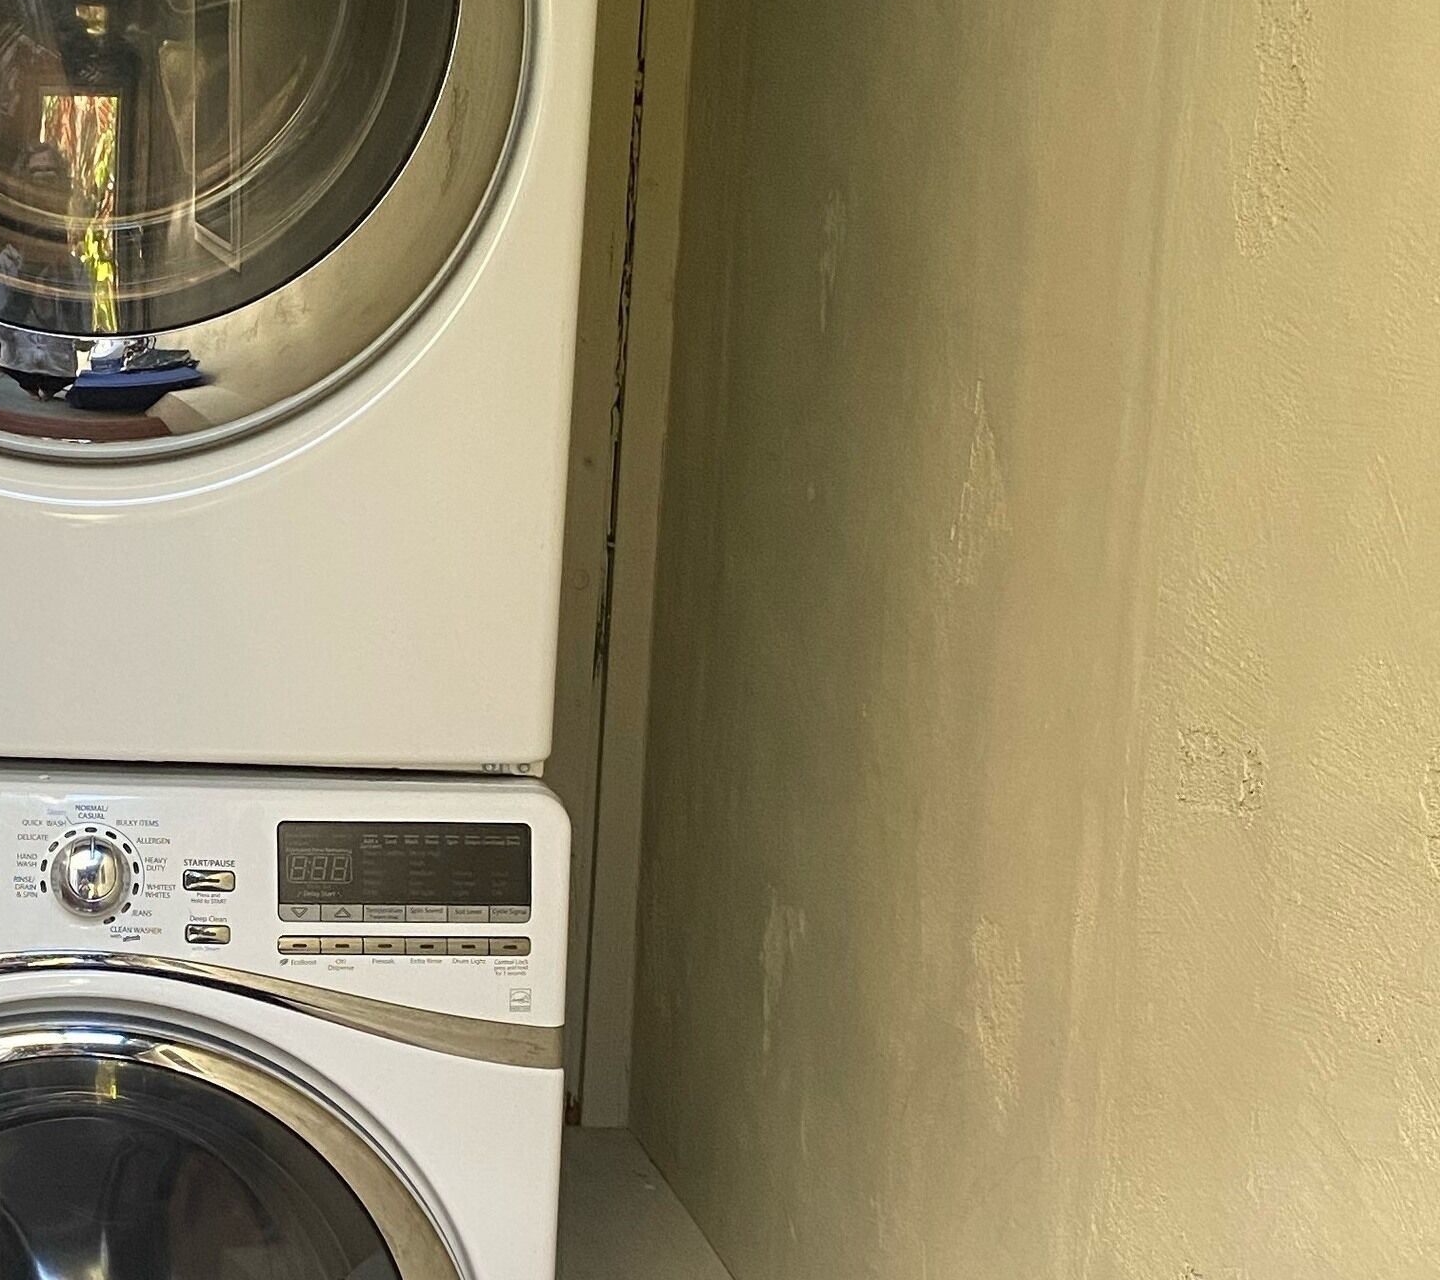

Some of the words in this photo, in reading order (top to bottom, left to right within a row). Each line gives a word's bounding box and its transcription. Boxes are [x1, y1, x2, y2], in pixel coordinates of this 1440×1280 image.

[75, 804, 109, 813] NORMAL/
[77, 812, 105, 820] CASUAL
[46, 820, 67, 828] WASH
[115, 819, 138, 827] BULKY
[17, 833, 49, 841] DELICATE
[136, 837, 171, 845] ALLERGEN
[144, 857, 168, 865] HEAVY
[183, 858, 236, 868] START/PAUSE
[146, 864, 166, 872] DUTY
[146, 884, 176, 892] WHITEST
[145, 891, 171, 899] WHITES
[189, 914, 208, 924] Deep
[208, 915, 228, 923] Clean
[110, 926, 133, 934] CLEAN
[133, 927, 163, 935] WASHER
